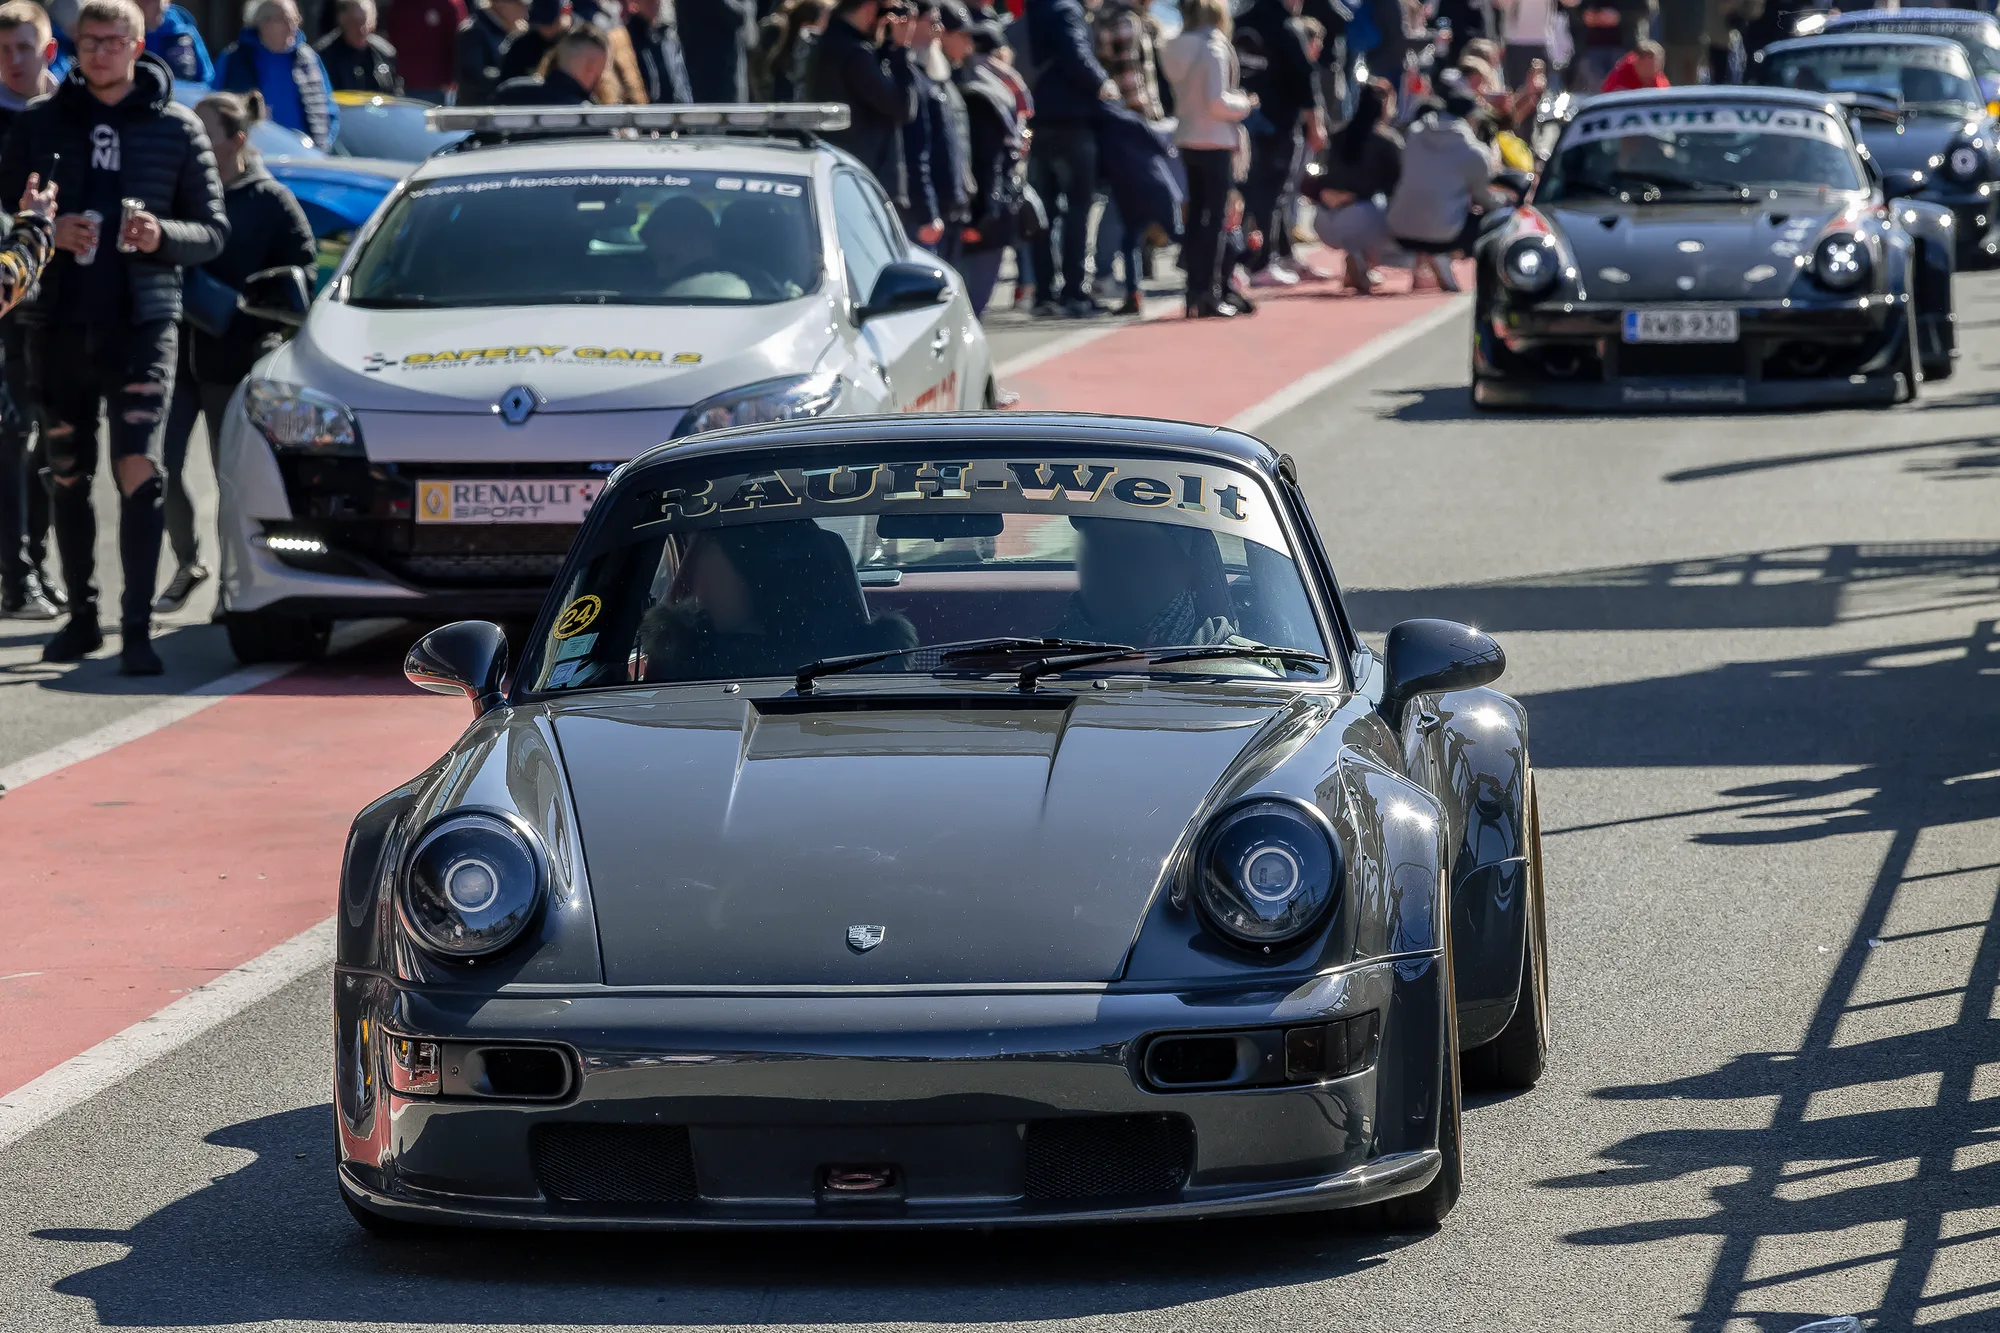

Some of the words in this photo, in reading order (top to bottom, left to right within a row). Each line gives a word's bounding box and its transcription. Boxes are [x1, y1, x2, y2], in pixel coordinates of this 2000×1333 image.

[409, 173, 691, 199] www.spa-francorchamps.be
[403, 344, 568, 365] SAFETY
[573, 345, 664, 362] CAR
[672, 351, 703, 364] 2
[453, 483, 577, 505] RENAULT
[454, 505, 545, 518] SPORT
[558, 603, 593, 631] 24
